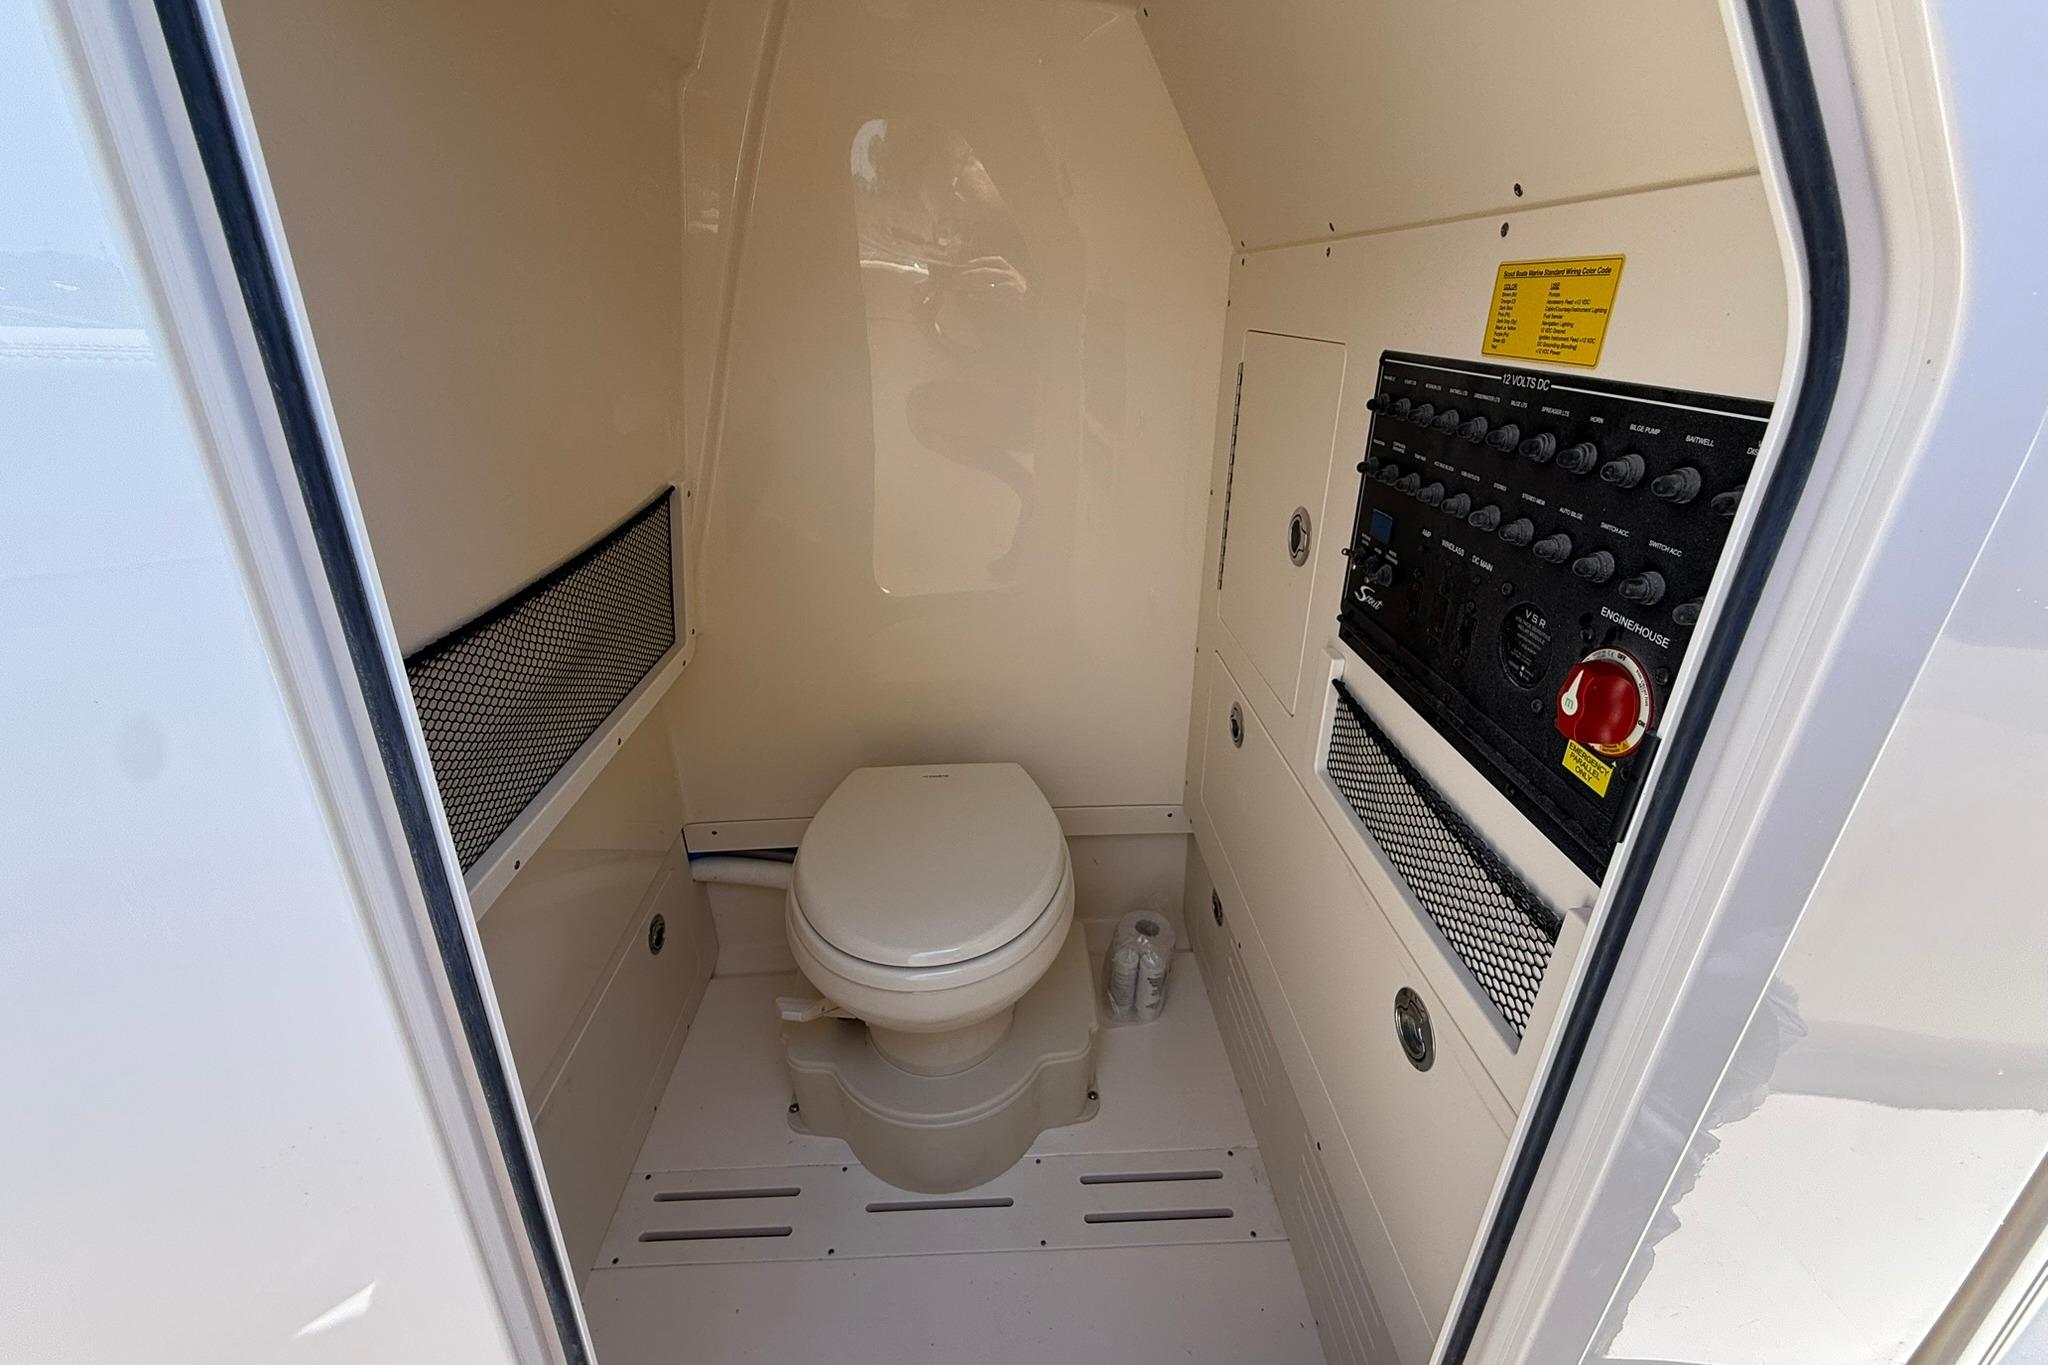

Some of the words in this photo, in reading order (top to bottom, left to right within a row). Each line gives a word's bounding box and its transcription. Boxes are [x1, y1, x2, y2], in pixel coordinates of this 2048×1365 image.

[1544, 268, 1565, 276] Standard
[1565, 268, 1581, 276] Wiring
[1582, 267, 1596, 275] Color
[1596, 266, 1612, 274] Code
[1502, 373, 1511, 385] 12
[1511, 374, 1536, 390] VOLTS
[1537, 378, 1550, 391] DC
[1541, 406, 1562, 415] SPREADER
[1562, 409, 1570, 417] LTS
[1590, 415, 1605, 425] HORN
[1629, 423, 1645, 433] BILGE
[1645, 426, 1661, 436] PUMP
[1685, 434, 1714, 448] BAITWELL
[1559, 507, 1571, 517] AUTO
[1570, 510, 1584, 521] BILGE
[1600, 521, 1619, 534] SWITCH
[1617, 528, 1630, 538] ACC
[1441, 538, 1465, 557] WINDLASS
[1649, 539, 1670, 553] SWITCH
[1668, 546, 1683, 558] ACC
[1471, 554, 1480, 566] DC
[1479, 559, 1494, 573] MAIN
[1354, 585, 1385, 611] Scout
[1600, 606, 1671, 649] ENGINE/HOUSE
[1637, 719, 1646, 728] ON
[1569, 741, 1610, 777] EMERGENCY
[1569, 752, 1601, 781] PARALLEL
[1575, 765, 1593, 782] ONLY
